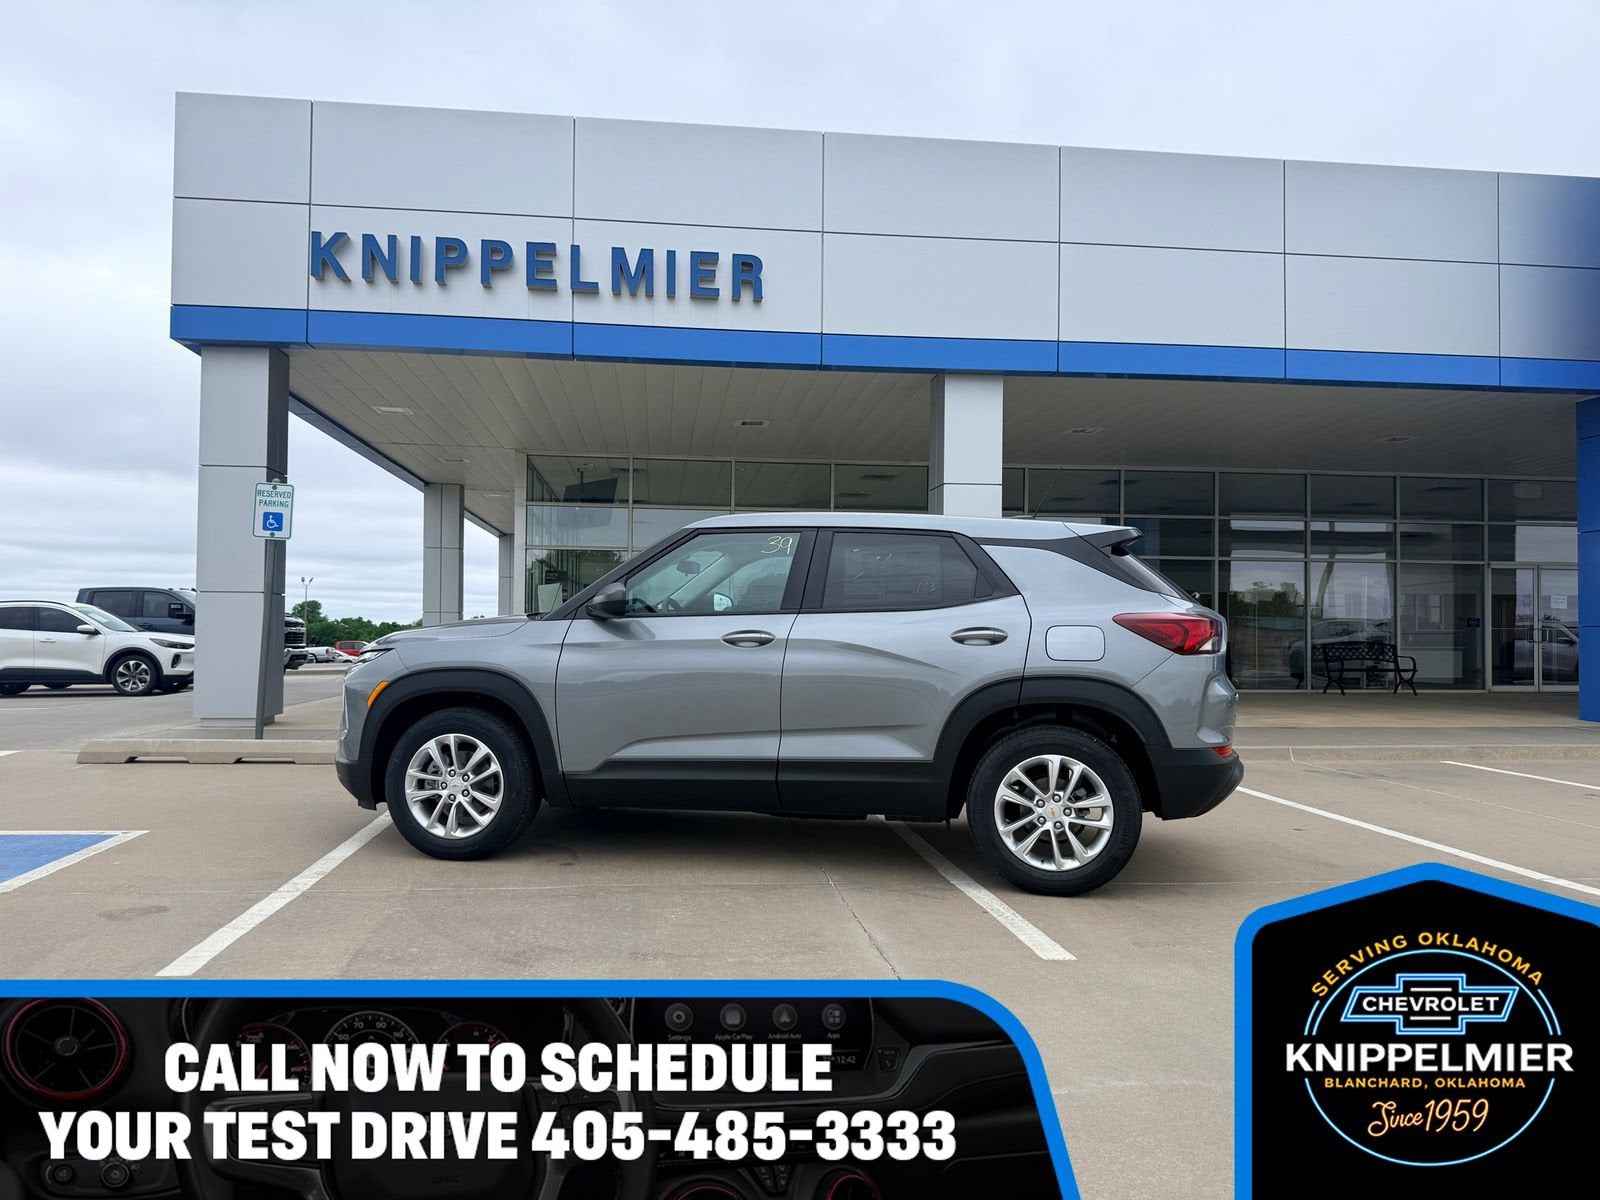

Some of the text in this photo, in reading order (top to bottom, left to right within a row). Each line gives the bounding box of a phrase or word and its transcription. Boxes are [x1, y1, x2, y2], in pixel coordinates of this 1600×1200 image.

[311, 230, 764, 302] KNIPPELMIER
[257, 490, 291, 499] RESERVED
[259, 499, 289, 508] PARKING
[761, 536, 793, 555] 39
